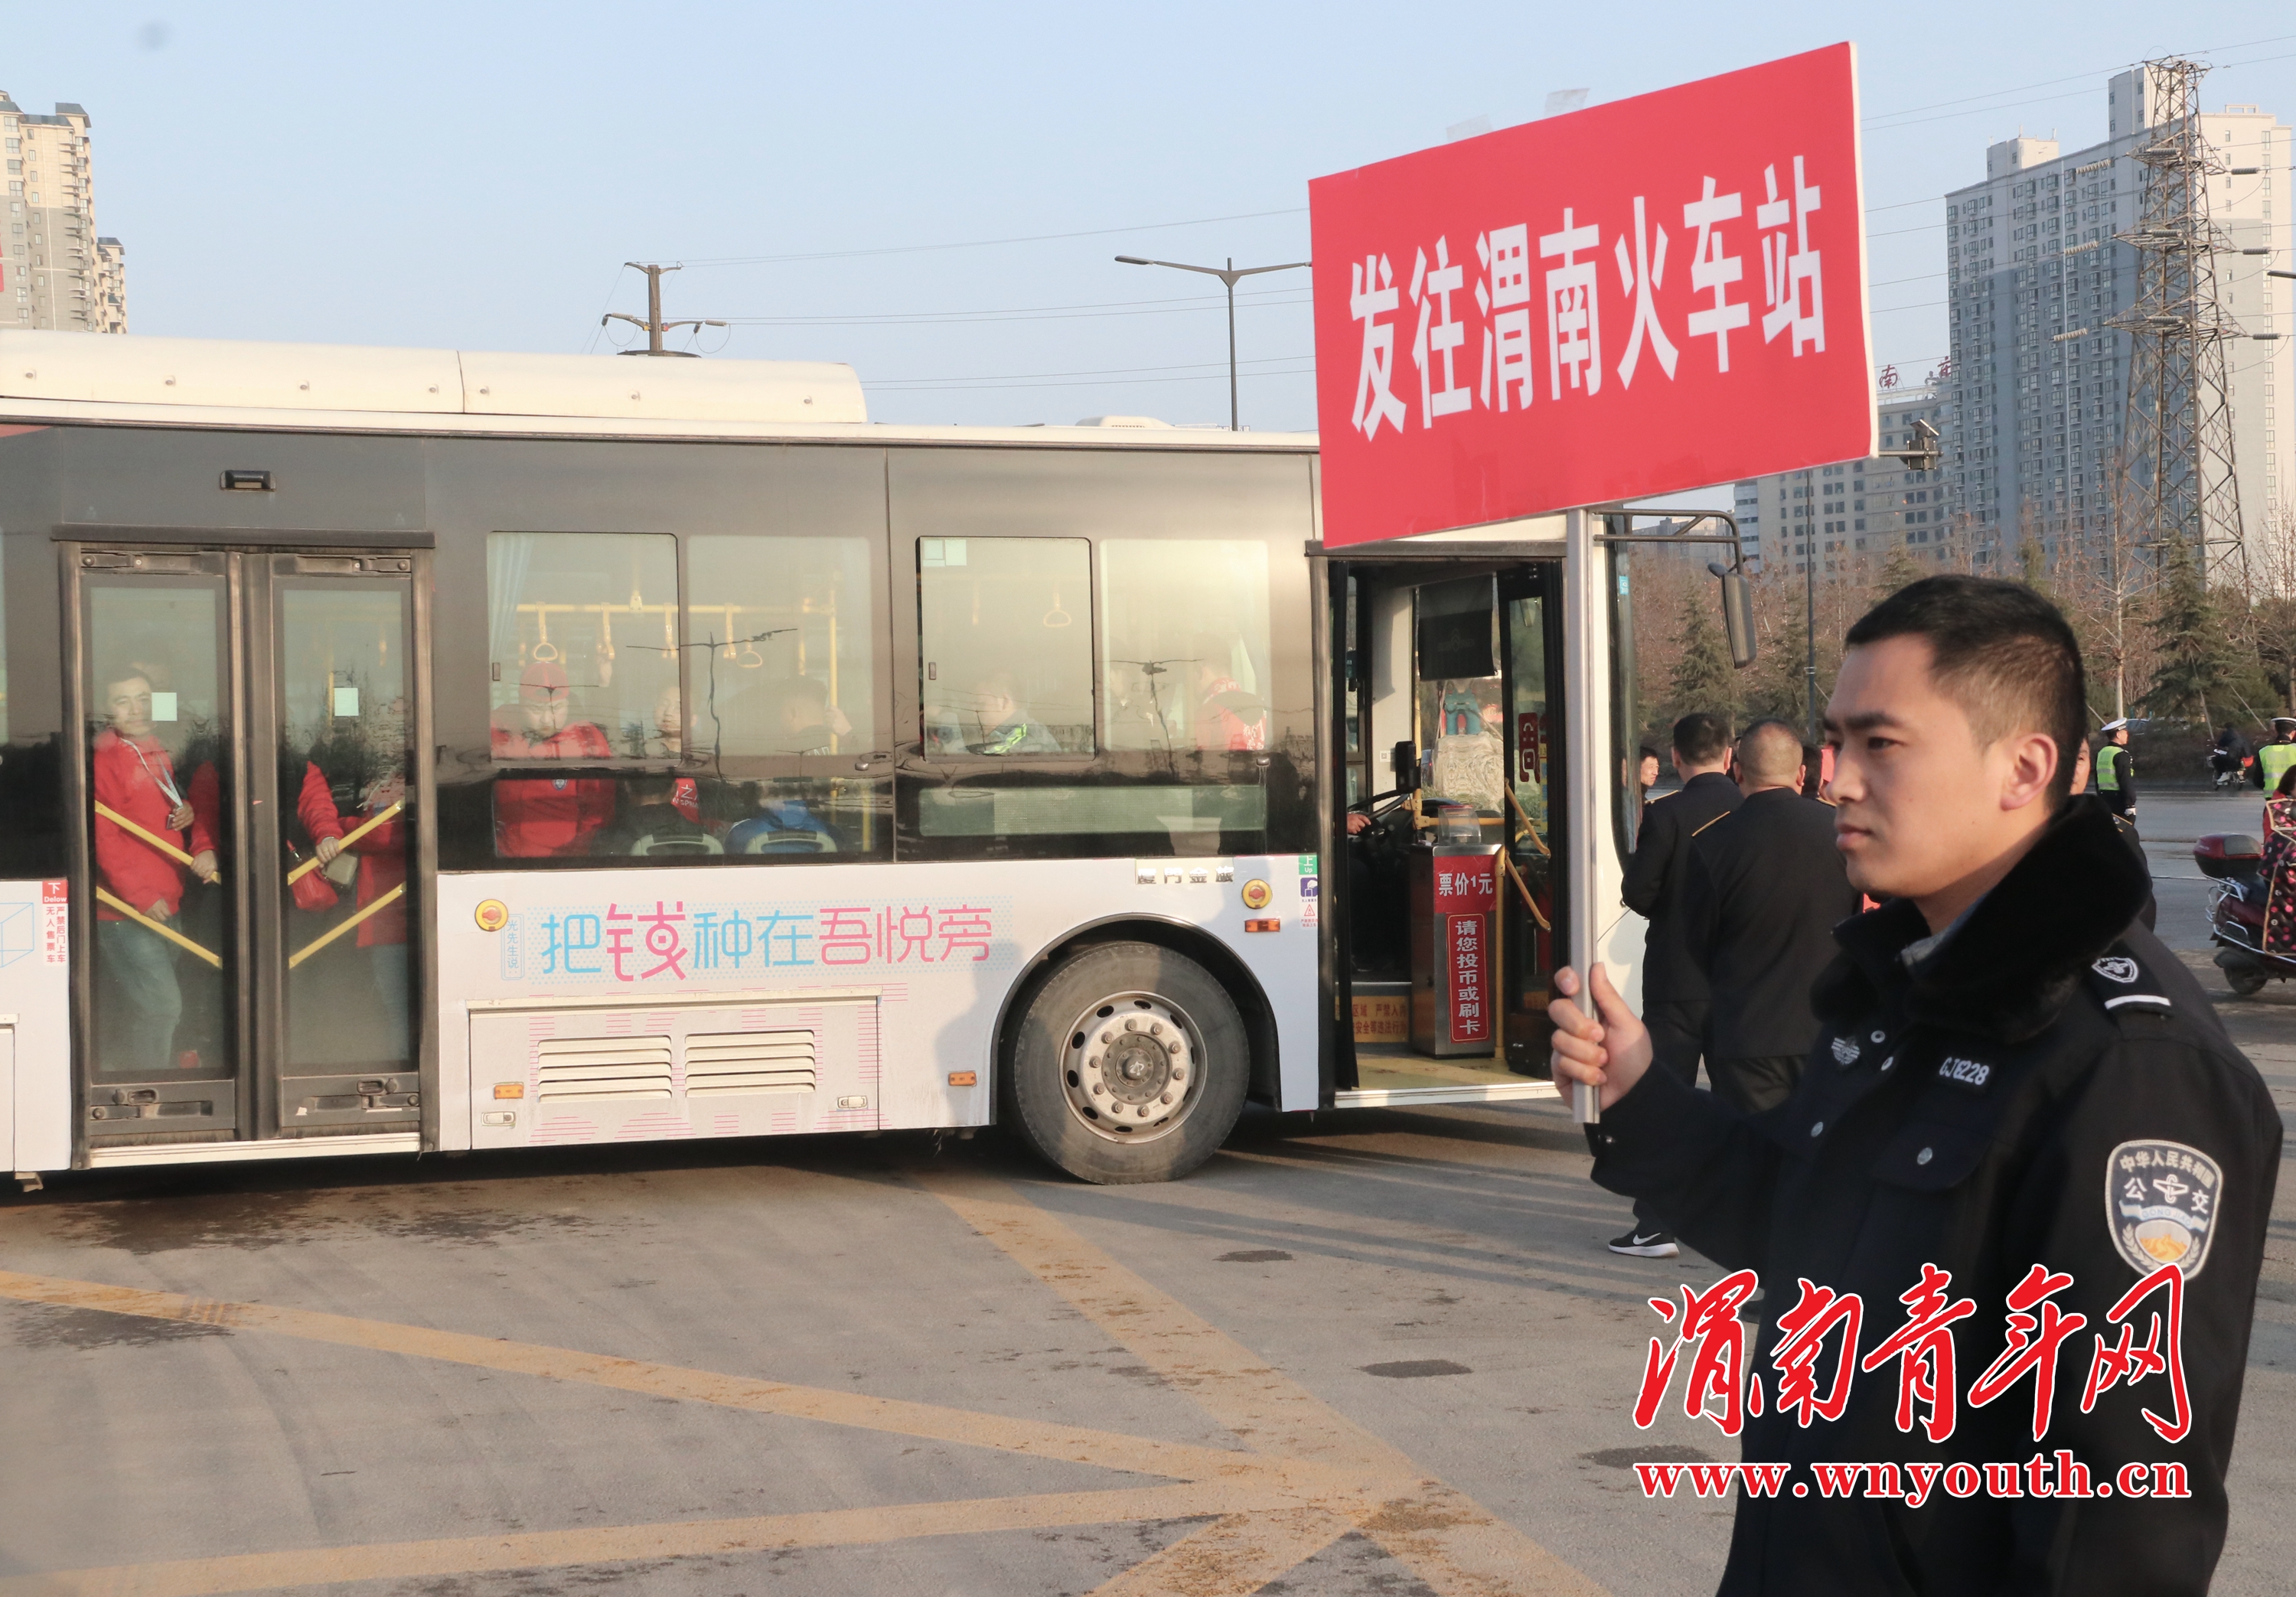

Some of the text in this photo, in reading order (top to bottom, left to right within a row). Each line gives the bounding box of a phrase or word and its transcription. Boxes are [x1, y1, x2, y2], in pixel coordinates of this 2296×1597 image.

[1350, 155, 1825, 442] 发往渭南火车站
[1303, 856, 1313, 866] 上
[48, 882, 60, 895] 下
[1439, 872, 1492, 897] 票价1元
[46, 906, 55, 963] 无人售票车
[56, 906, 66, 963] 严禁后门上车
[540, 901, 993, 983] 把钱种在吾悦旁
[1455, 920, 1481, 1035] 请您投币或刷卡
[1353, 1020, 1407, 1035] 安全等违法行为
[2119, 1150, 2216, 1189] 中华人民共和国
[2141, 1207, 2171, 1218] GONG
